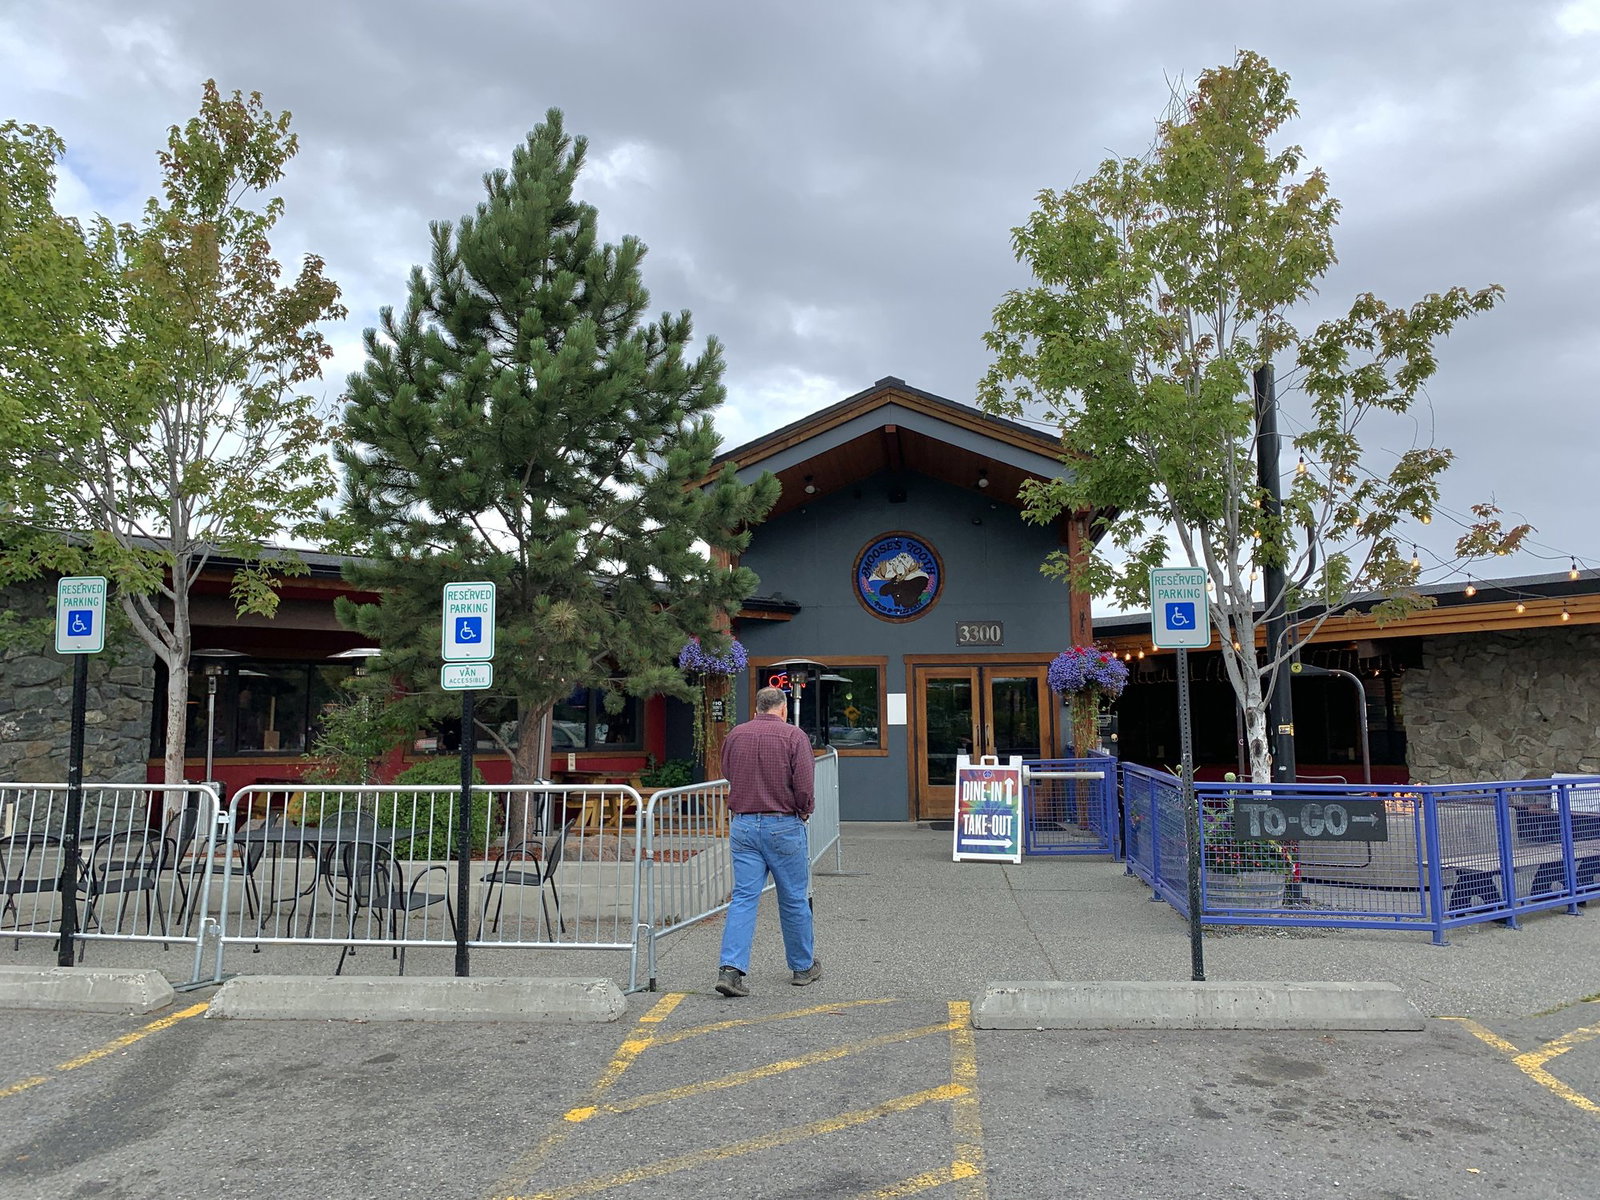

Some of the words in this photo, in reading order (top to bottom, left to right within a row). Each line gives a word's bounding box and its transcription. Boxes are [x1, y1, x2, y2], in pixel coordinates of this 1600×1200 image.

[906, 541, 936, 575] TOOTH
[1154, 575, 1203, 586] RESERVED
[61, 584, 103, 594] RESERVED
[1158, 588, 1201, 599] PARKING
[448, 590, 492, 600] RESERVED
[63, 597, 99, 607] PARKING
[450, 603, 488, 613] PARKING
[960, 625, 1001, 642] 3300
[459, 669, 476, 677] VAN
[963, 780, 1003, 802] DINE-IN
[962, 814, 1013, 836] TAKE-OUT
